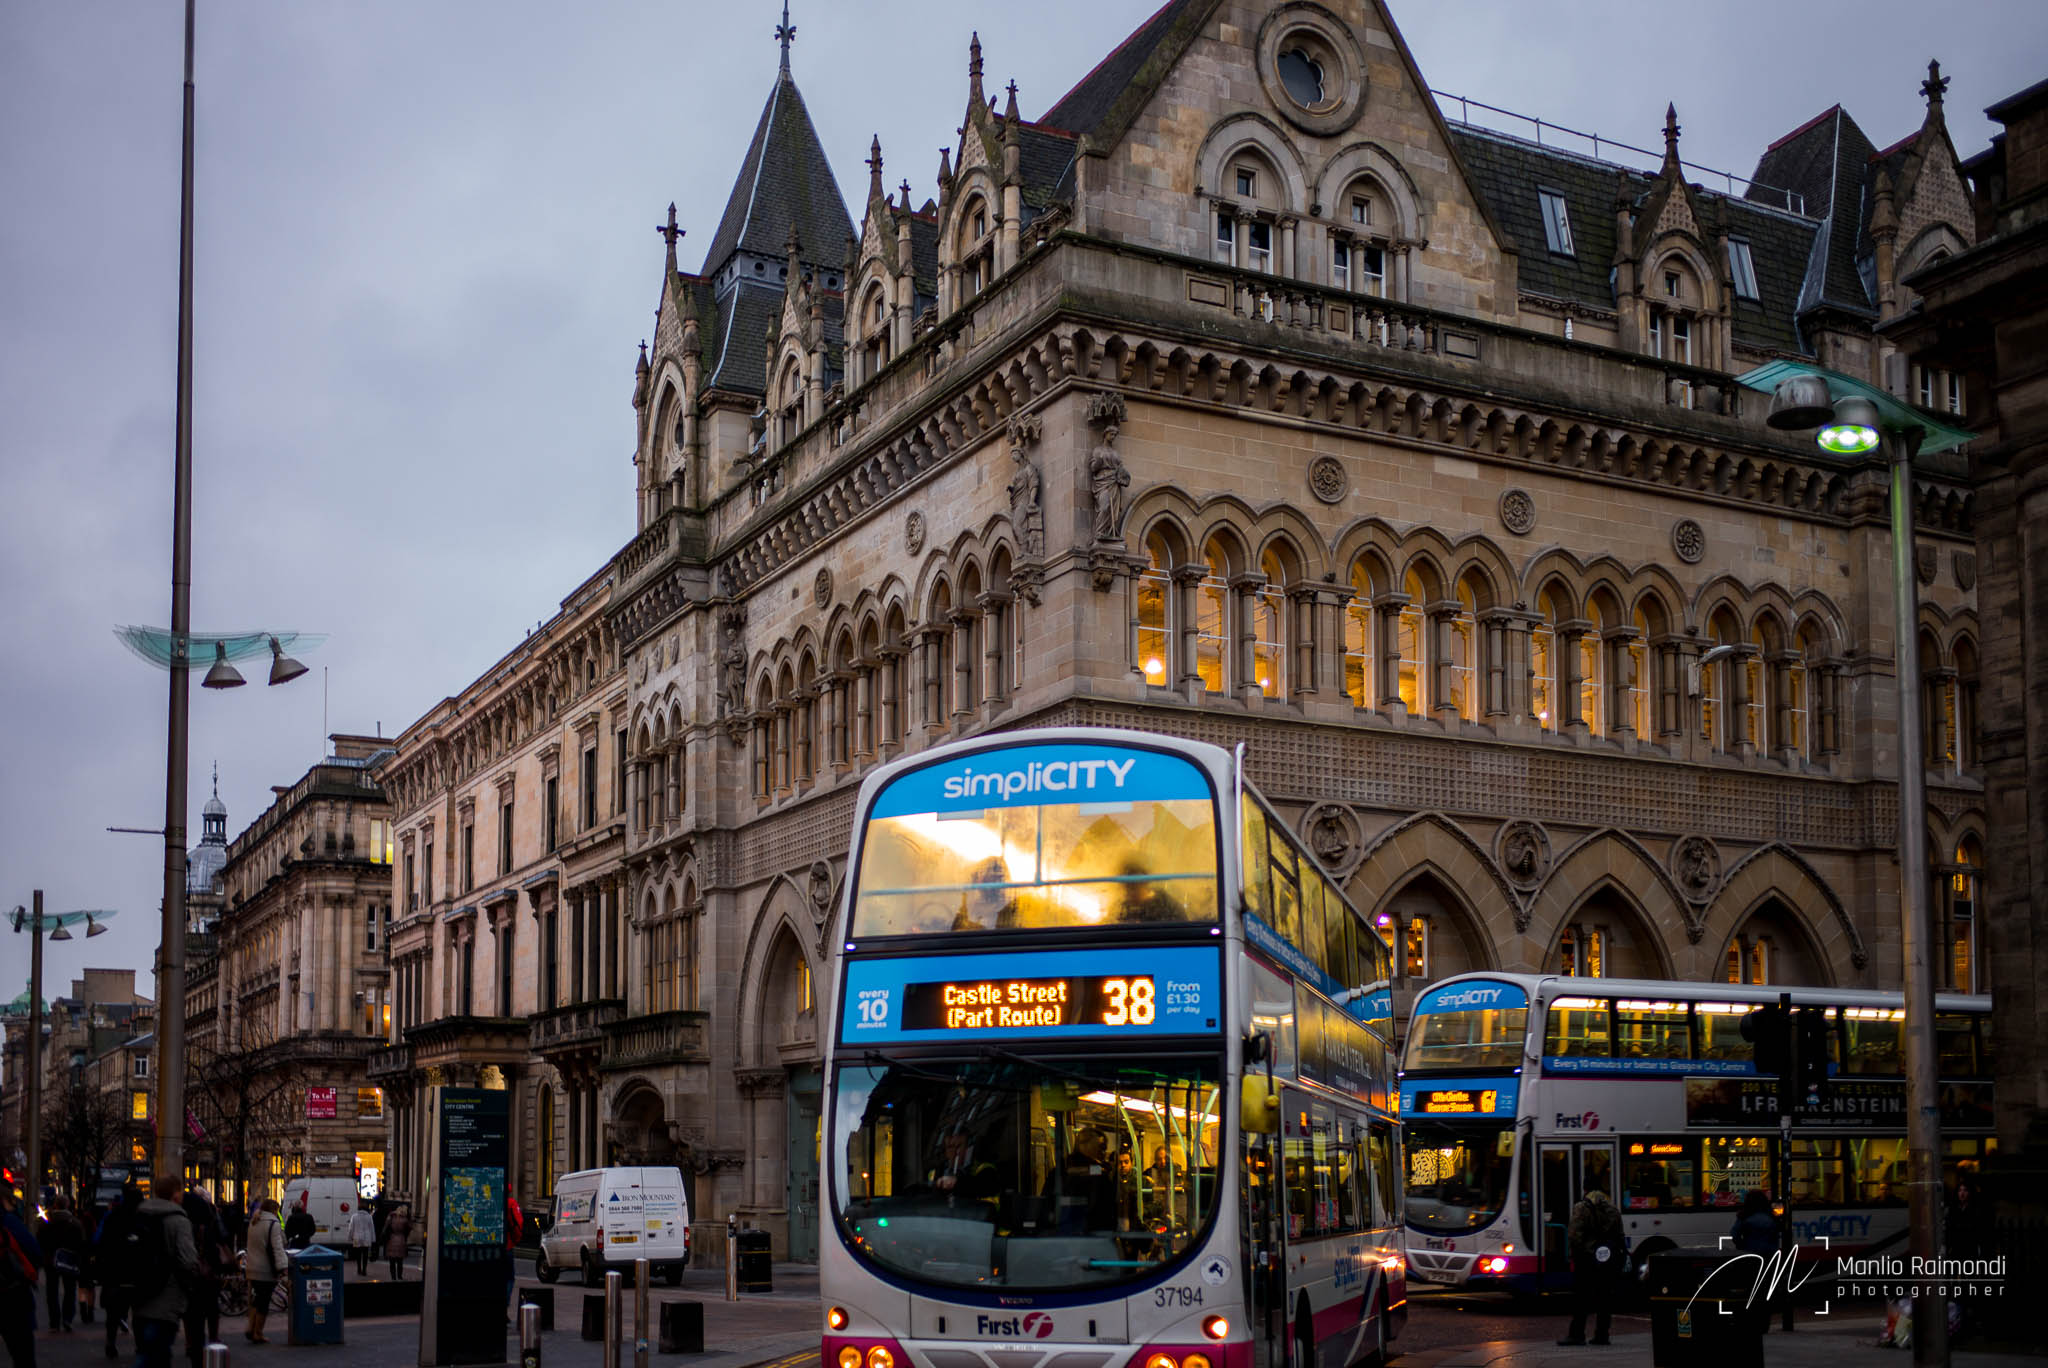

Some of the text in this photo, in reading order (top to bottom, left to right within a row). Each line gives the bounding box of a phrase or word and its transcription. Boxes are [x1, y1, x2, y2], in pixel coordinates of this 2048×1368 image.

[943, 758, 1137, 802] simpliCITY
[858, 989, 889, 1000] every
[944, 981, 1067, 1006] Castle Street
[1166, 981, 1201, 992] from
[1102, 978, 1156, 1027] 38
[1166, 993, 1201, 1004] £1.30
[1437, 988, 1504, 1009] simpliCITY
[857, 998, 889, 1022] 10
[947, 1004, 1062, 1029] (Part Route)
[1166, 1005, 1201, 1015] per day
[1556, 1112, 1581, 1129] First
[1154, 1286, 1204, 1308] 37194
[976, 1314, 1021, 1336] First
